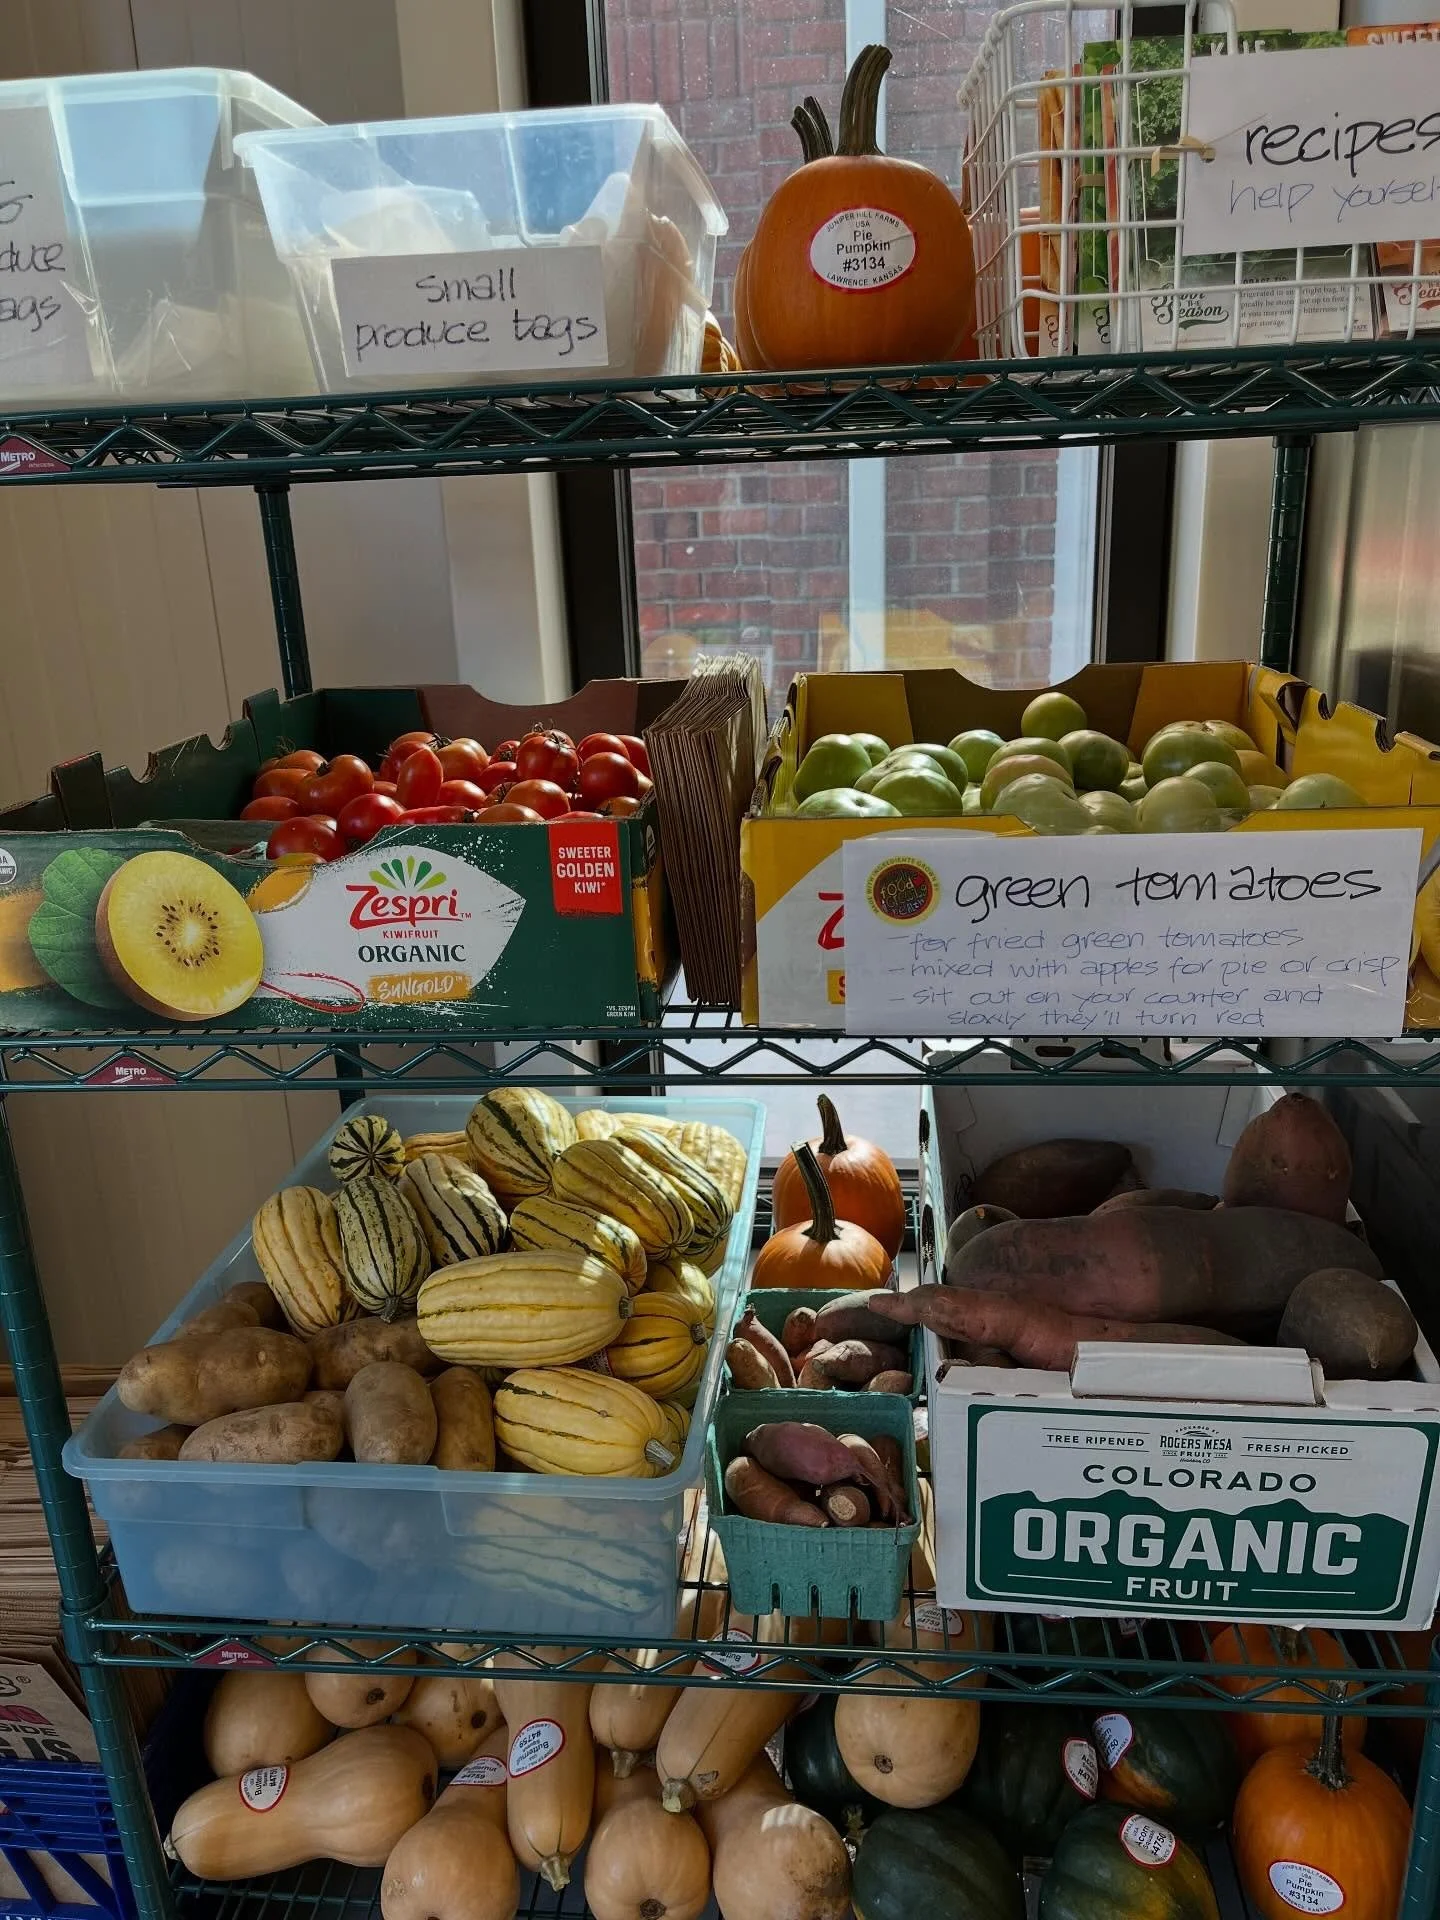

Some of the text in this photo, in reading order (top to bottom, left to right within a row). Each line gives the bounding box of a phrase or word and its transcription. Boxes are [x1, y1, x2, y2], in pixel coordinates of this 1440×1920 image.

[1230, 176, 1440, 224] help yoursel
[855, 220, 871, 228] USA
[874, 212, 900, 228] FARMS
[853, 230, 873, 241] Pie
[836, 240, 891, 255] Pumpkin
[842, 256, 886, 273] #3134
[872, 265, 903, 285] KANSAS
[356, 320, 490, 362] produce
[558, 847, 611, 859] SWEETER
[556, 863, 615, 878] GOLDEN
[956, 866, 1382, 924] green tomatoes
[346, 885, 462, 930] Zespri
[383, 930, 439, 939] KIWIFRUIT
[910, 933, 956, 960] for
[968, 930, 1045, 959] fried
[1062, 932, 1144, 959] green
[1159, 927, 1304, 948] tomatoes
[358, 944, 467, 963] ORGANIC
[911, 959, 993, 978] mixed
[1009, 958, 1067, 979] with
[1080, 958, 1160, 985] apples
[1169, 957, 1213, 983] for
[1222, 954, 1267, 987] pie
[1280, 954, 1319, 974] or
[1326, 951, 1401, 987] crisp
[913, 986, 952, 1006] sit
[969, 988, 1015, 1006] out
[1026, 992, 1061, 1005] on
[1072, 987, 1136, 1013] your
[1144, 987, 1249, 1007] counter
[1263, 985, 1323, 1005] and
[1136, 1010, 1197, 1026] turn
[1217, 1008, 1264, 1028] red
[115, 1067, 147, 1076] METRO
[1047, 1434, 1145, 1447] TREE RIPENED
[1160, 1435, 1232, 1451] ROGERS MESA
[1247, 1443, 1349, 1455] FRESH PICKED
[1180, 1450, 1212, 1458] FRUIT
[1082, 1464, 1317, 1493] COLORADO
[1013, 1508, 1362, 1576] ORGANIC
[1126, 1577, 1239, 1601] FRUIT
[221, 1651, 249, 1659] METRO
[1286, 1878, 1325, 1898] Pumpkin
[1298, 1877, 1313, 1888] Pie
[1288, 1889, 1319, 1906] #3134
